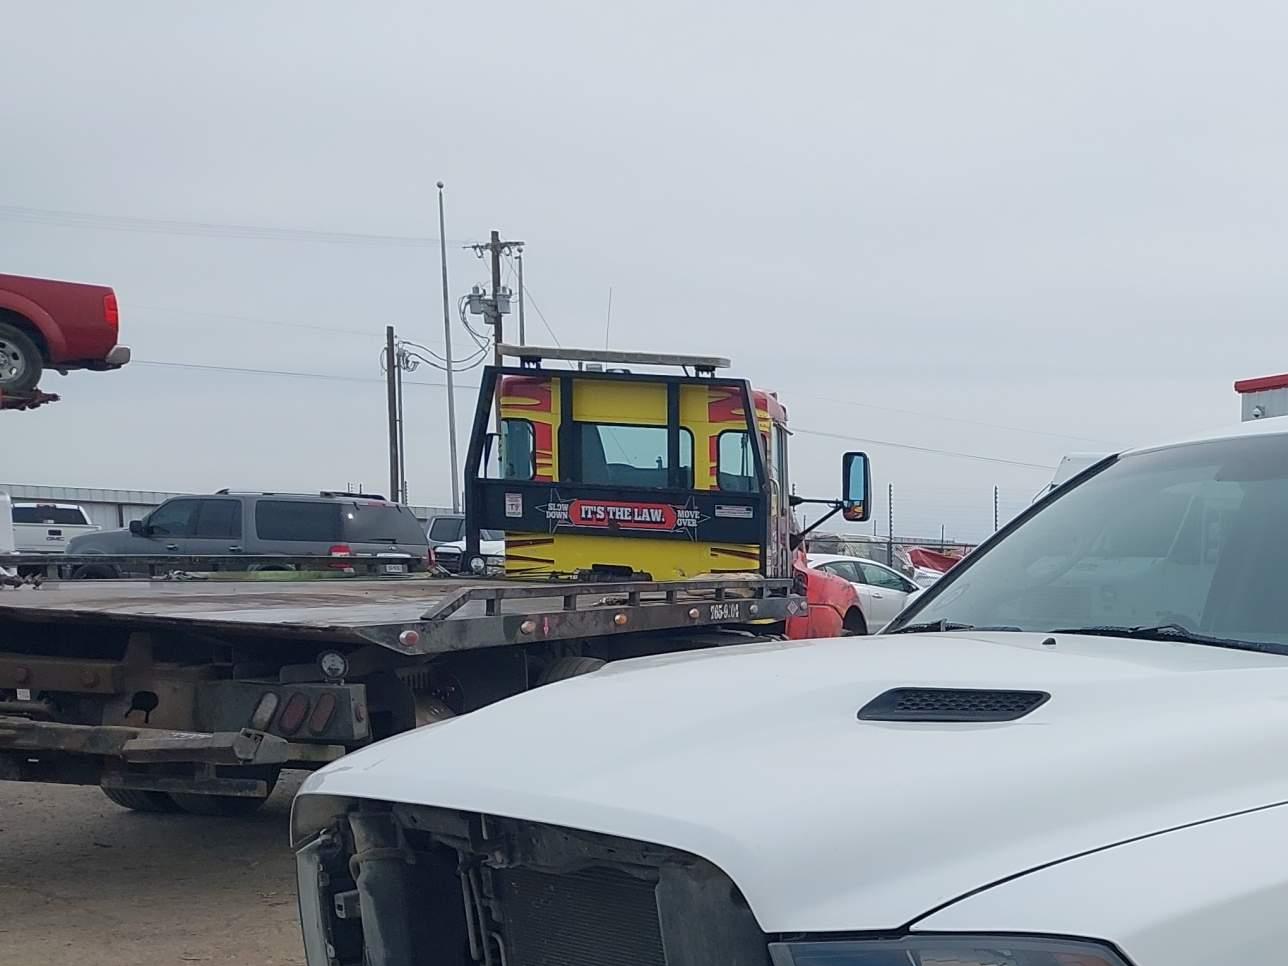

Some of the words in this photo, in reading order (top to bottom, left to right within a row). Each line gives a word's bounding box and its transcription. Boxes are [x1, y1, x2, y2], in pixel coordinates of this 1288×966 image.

[547, 502, 568, 511] SLOW
[546, 510, 568, 519] DOWN
[581, 505, 604, 519] IT'S
[606, 507, 631, 521] THE
[634, 509, 665, 523] LAW.
[677, 509, 700, 519] MOVE
[677, 518, 698, 527] OVER
